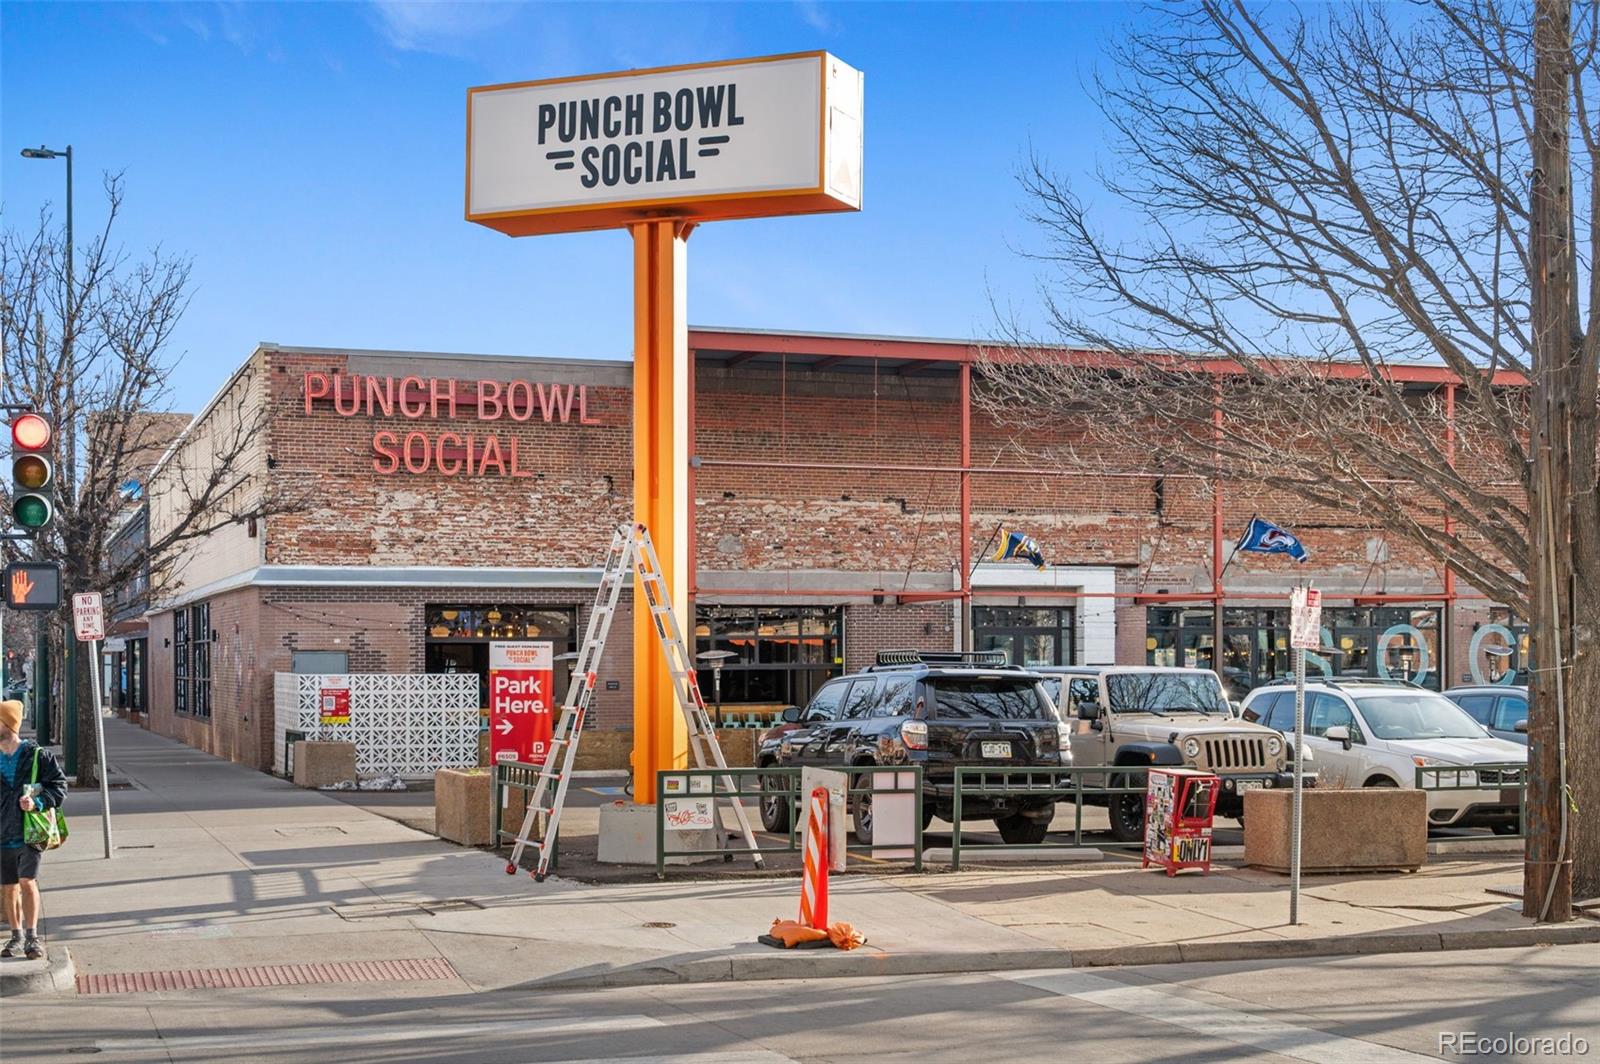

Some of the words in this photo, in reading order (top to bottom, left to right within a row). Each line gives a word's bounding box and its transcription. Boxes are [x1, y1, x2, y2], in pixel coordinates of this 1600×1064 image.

[537, 93, 644, 145] PUNCH
[653, 83, 745, 134] BOWL
[580, 137, 696, 189] SOCIAL
[304, 372, 456, 418] PUNCH
[476, 380, 601, 425] BOWL
[372, 431, 533, 477] SOCIAL
[82, 596, 92, 605] NO
[76, 607, 100, 616] PARKING
[524, 649, 538, 657] BOWL
[495, 676, 542, 694] Park
[495, 696, 549, 714] Here.
